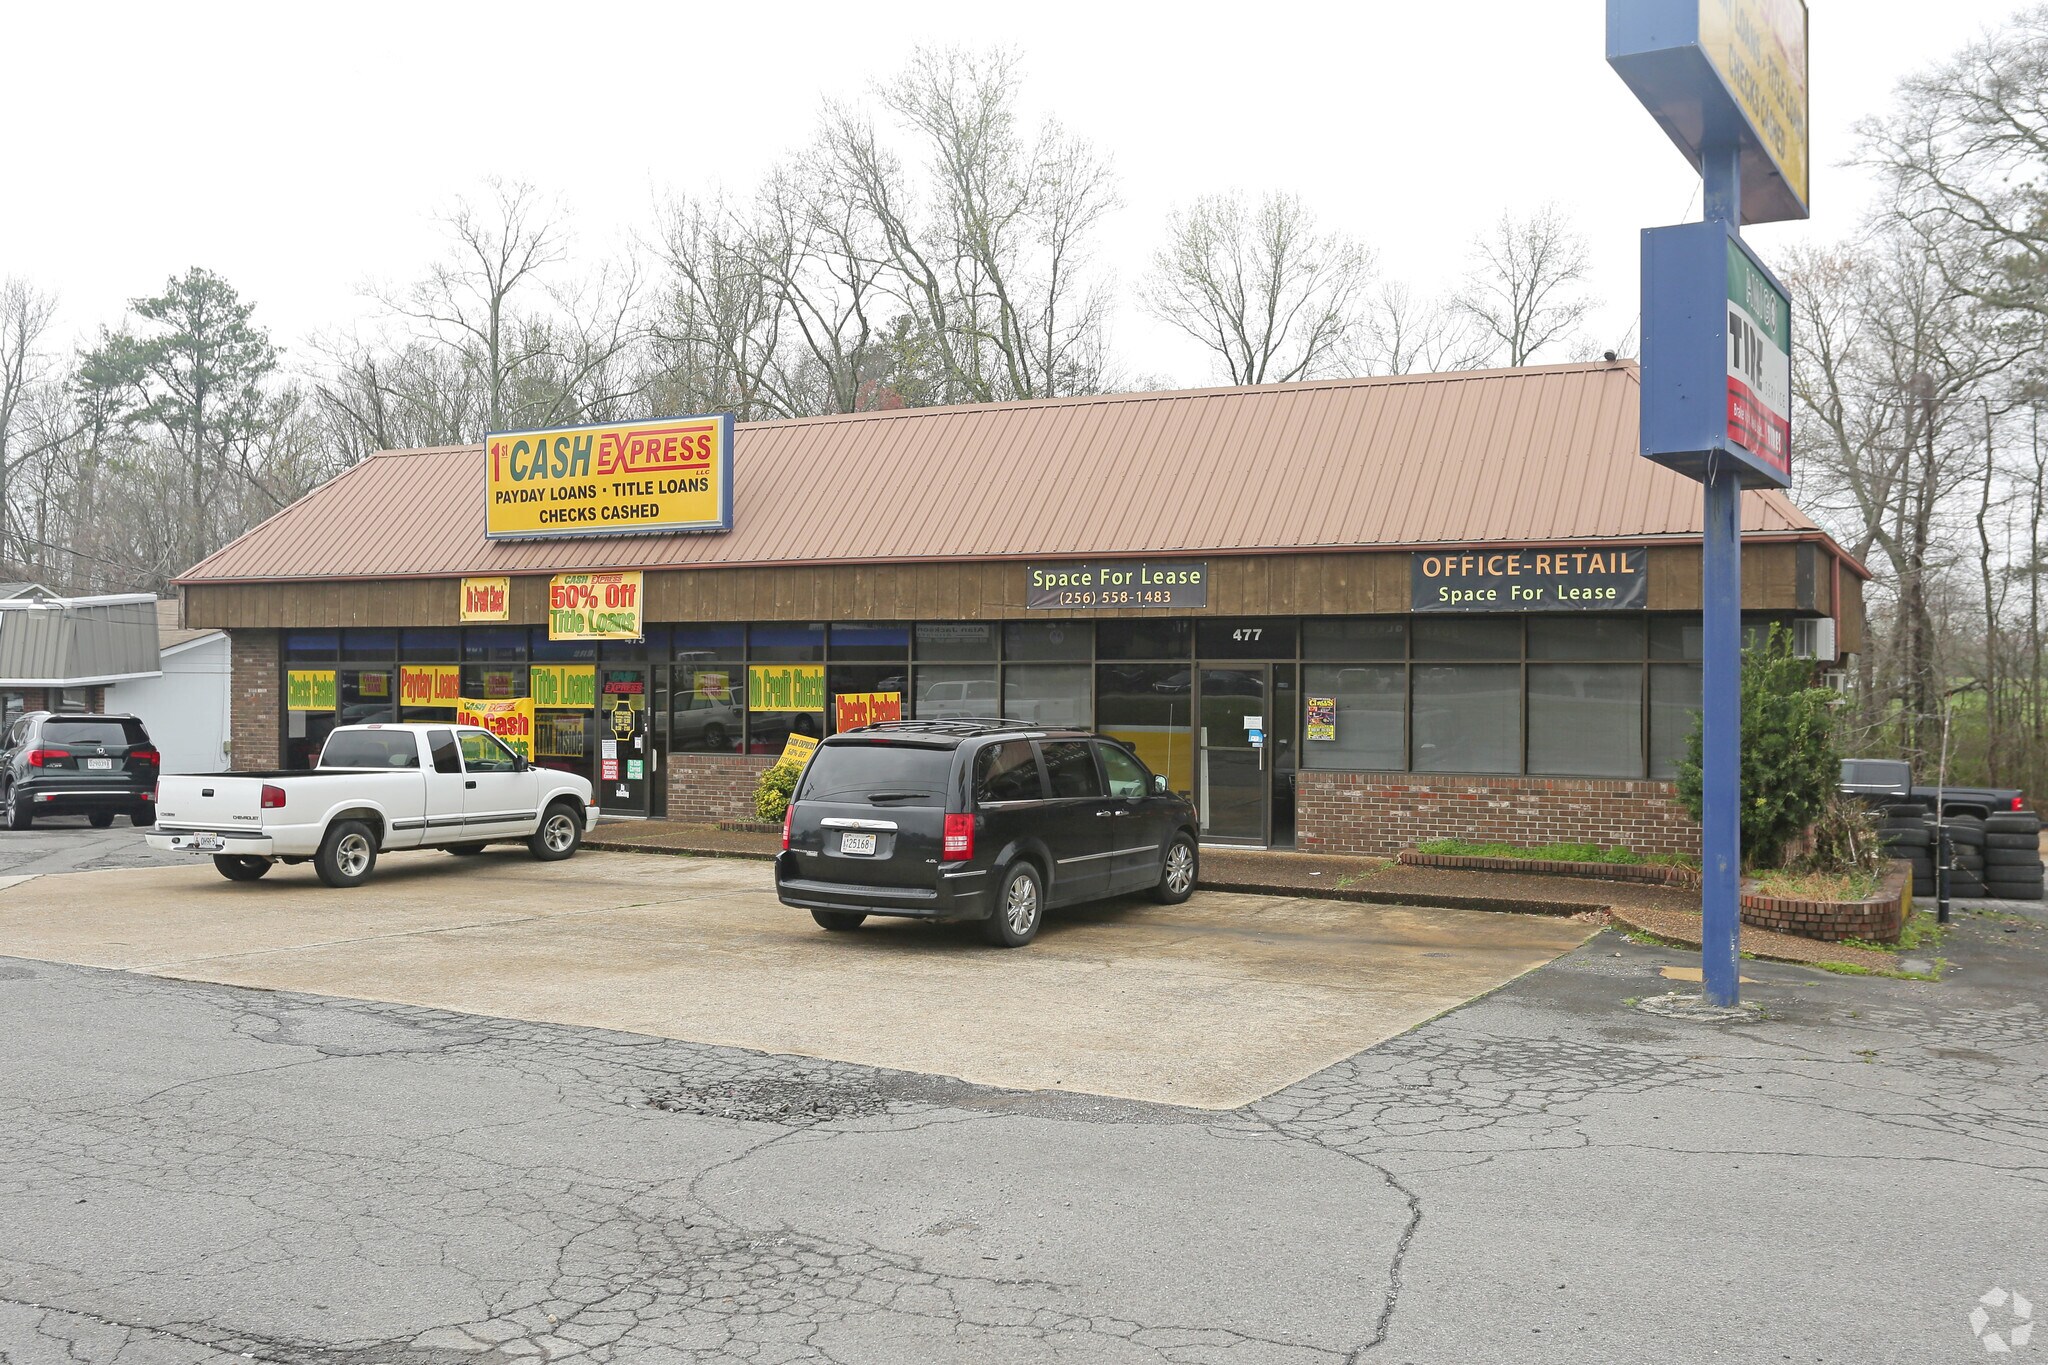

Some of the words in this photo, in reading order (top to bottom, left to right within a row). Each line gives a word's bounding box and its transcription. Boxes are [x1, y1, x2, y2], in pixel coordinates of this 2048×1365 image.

[1729, 311, 1763, 392] TIRE
[491, 443, 508, 482] 1st
[510, 435, 593, 482] CASH
[597, 427, 713, 475] EXPRESS
[496, 488, 546, 504] PAYDAY
[550, 485, 597, 501] LOANS
[612, 481, 654, 497] TITLE
[658, 478, 709, 494] LOANS
[539, 507, 597, 523] CHECKS
[601, 503, 659, 519] CASHED
[1422, 553, 1635, 577] OFFICE-RETAIL
[565, 575, 588, 584] CASH
[591, 574, 623, 584] EXPRESS
[1033, 570, 1092, 590] Space
[1100, 569, 1133, 585] For
[1142, 568, 1201, 584] Lease
[551, 585, 598, 608] 50%
[605, 584, 636, 608] Off
[1060, 591, 1096, 605] (256)
[1102, 591, 1171, 603] 558-1483
[1439, 587, 1497, 605] Space
[1511, 585, 1544, 600] For
[1558, 584, 1616, 600] Lease
[550, 609, 584, 633] Title
[588, 609, 635, 633] Loans
[1233, 629, 1262, 641] 477
[289, 673, 311, 706] Checks
[402, 668, 432, 703] Payday
[435, 669, 459, 699] Loans
[531, 669, 557, 705] Title
[561, 669, 595, 705] Loans
[750, 670, 761, 707] No
[764, 669, 791, 707] Credit
[794, 669, 824, 707] Checks
[458, 712, 479, 726] No
[484, 713, 528, 736] Cash
[838, 695, 867, 733] Checks
[849, 839, 869, 849] 25168
